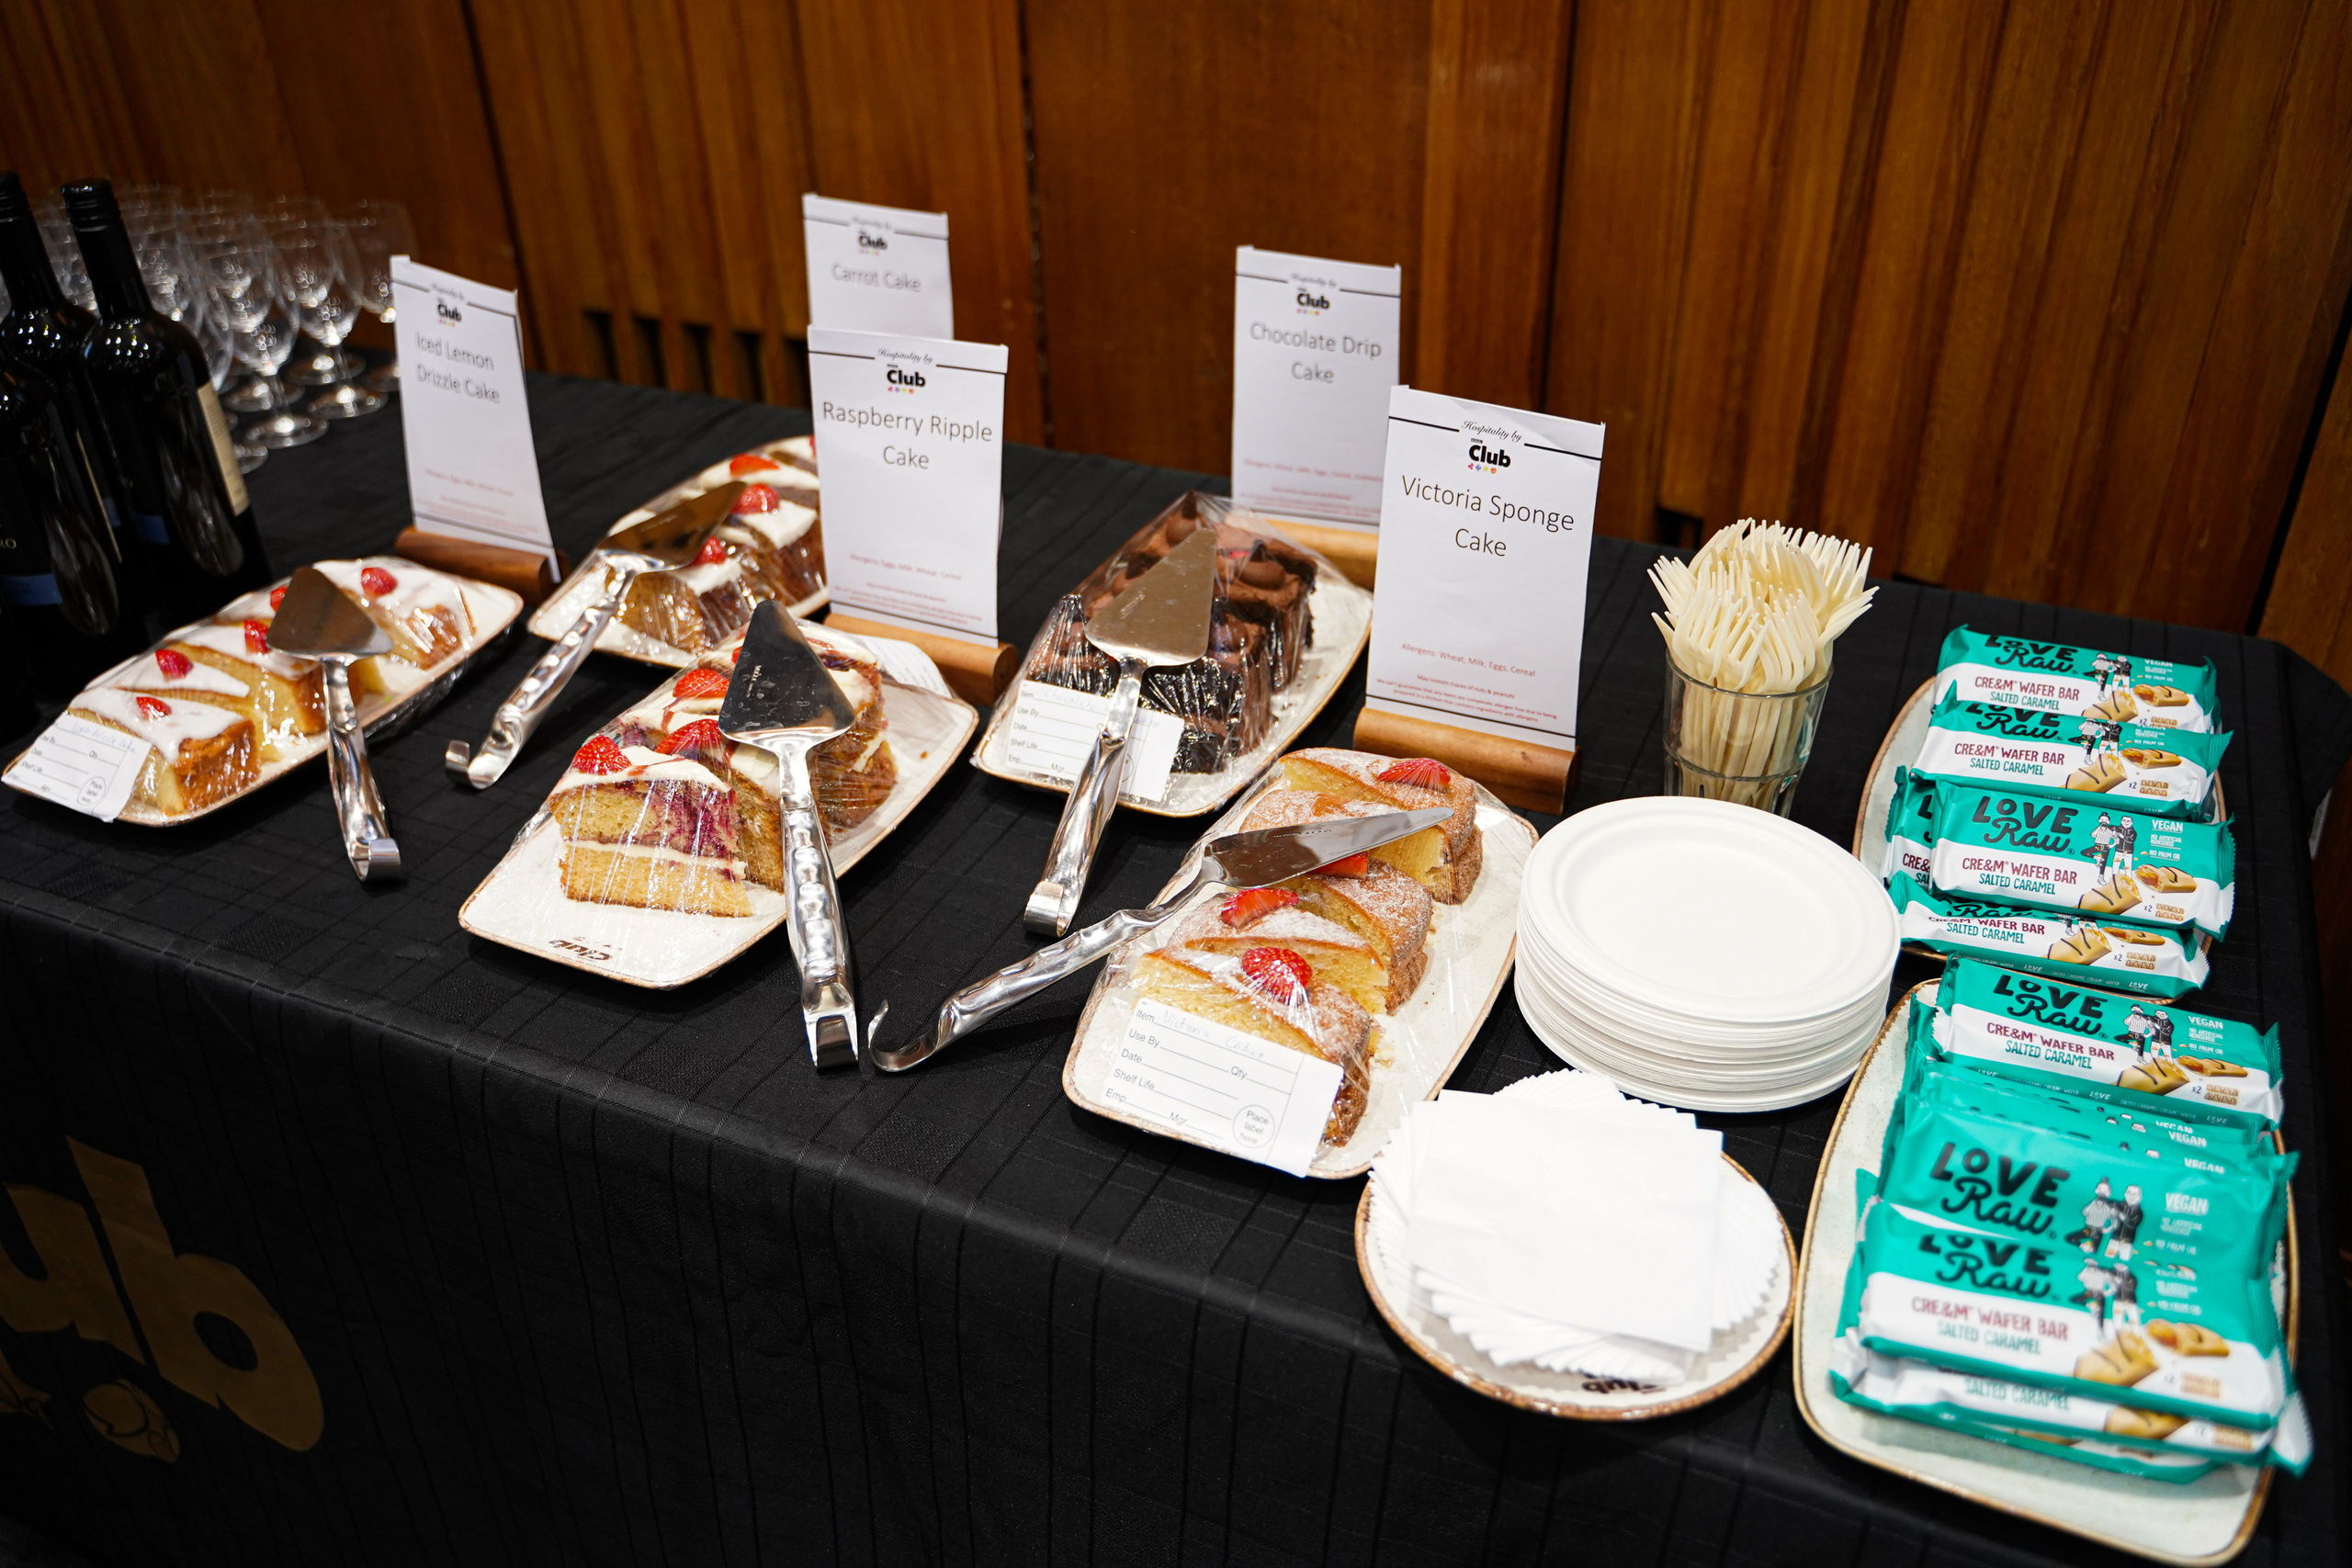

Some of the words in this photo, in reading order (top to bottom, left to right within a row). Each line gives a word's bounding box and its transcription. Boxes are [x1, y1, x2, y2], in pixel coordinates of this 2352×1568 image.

[858, 234, 888, 252] Club
[831, 263, 879, 288] Carrot
[882, 270, 922, 293] Cake
[436, 302, 462, 323] Club
[1296, 292, 1330, 310] Club
[416, 331, 443, 356] Iced
[447, 341, 494, 371] Lemon
[1250, 321, 1337, 353] Chocolate
[1342, 336, 1382, 358] Drip
[877, 349, 922, 364] Hospitality
[417, 363, 461, 395] Drizzle
[464, 378, 501, 405] Cake
[887, 369, 926, 388] Club
[1292, 361, 1335, 384] Cake
[823, 400, 923, 435] Raspberry
[930, 415, 993, 443] Ripple
[1462, 421, 1510, 440] Hospitality
[1511, 430, 1522, 443] by
[883, 446, 930, 469] Cake
[1469, 445, 1511, 468] Club
[1402, 475, 1481, 512] Victoria
[1489, 494, 1575, 533] Sponge
[1454, 527, 1507, 558] Cake
[1984, 635, 2078, 662] LOVE
[1995, 646, 2074, 672] Raw
[1401, 643, 1437, 658] Allergens:
[1440, 652, 1466, 664] Wheat,
[1468, 657, 1487, 668] Milk,
[1488, 661, 1509, 673] Eggs,
[1510, 666, 1536, 678] Cereal
[1990, 691, 2019, 705] SALTED
[2021, 695, 2060, 710] CARAMEL
[2019, 682, 2055, 697] WAFER
[2058, 687, 2080, 701] BAR
[1017, 706, 1031, 715] Use
[1031, 709, 1039, 717] By
[1013, 722, 1027, 731] Date
[1976, 713, 2059, 739] Raw
[1011, 738, 1025, 748] Shelf
[1026, 742, 1038, 750] Life
[1009, 755, 1021, 763] Emp
[1051, 762, 1065, 772] Mgr
[1970, 758, 2000, 771] SALTED
[2003, 761, 2043, 775] CARAMEL
[2001, 748, 2039, 761] WAFER
[2041, 751, 2065, 765] BAR
[1972, 795, 2078, 834] LOVE
[2152, 819, 2183, 832] VEGAN
[1984, 817, 2071, 853] Raw
[1979, 873, 2010, 887] SALTED
[2013, 878, 2055, 895] CARAMEL
[2011, 863, 2050, 880] WAFER
[2053, 869, 2077, 885] BAR
[1947, 922, 1979, 936] SALTED
[1982, 927, 2025, 943] CARAMEL
[1978, 919, 2018, 931] WAFER
[2021, 923, 2045, 934] BAR
[1993, 975, 2108, 1019] LOVE
[1136, 1009, 1155, 1022] Item
[1163, 1009, 1211, 1039] Victoria
[2007, 994, 2101, 1034] Raw
[2188, 1016, 2223, 1029] VEGAN
[1121, 1048, 1142, 1064] Date
[1129, 1029, 1147, 1043] Use
[1148, 1035, 1160, 1049] By
[1230, 1066, 1247, 1080] Qty
[2005, 1040, 2041, 1058] SALTED
[2044, 1048, 2092, 1069] CARAMEL
[2041, 1035, 2084, 1054] WAFER
[2088, 1046, 2115, 1061] BAR
[1114, 1068, 1136, 1084] Shelf
[1138, 1077, 1155, 1091] Life
[2191, 1086, 2201, 1094] x2
[2090, 1091, 2110, 1100] LOVE
[1105, 1089, 1126, 1104] Emp
[1169, 1111, 1187, 1127] Mgr
[1246, 1110, 1269, 1125] Place
[1244, 1121, 1264, 1135] label
[2168, 1131, 2207, 1147] VEGAN
[1929, 1142, 2070, 1208] LOVE
[2184, 1157, 2224, 1175] VEGAN
[1940, 1177, 2053, 1235] Raw
[2165, 1192, 2209, 1215] VEGAN
[1918, 1234, 2053, 1276] LOVE
[1936, 1251, 2051, 1298] Raw
[1978, 1307, 2030, 1332] WAFER
[2037, 1318, 2069, 1341] BAR
[1937, 1320, 1979, 1342] SALTED
[1984, 1330, 2041, 1355] CARAMEL
[1964, 1378, 2007, 1400] SALTED
[2012, 1385, 2070, 1411] CARAMEL
